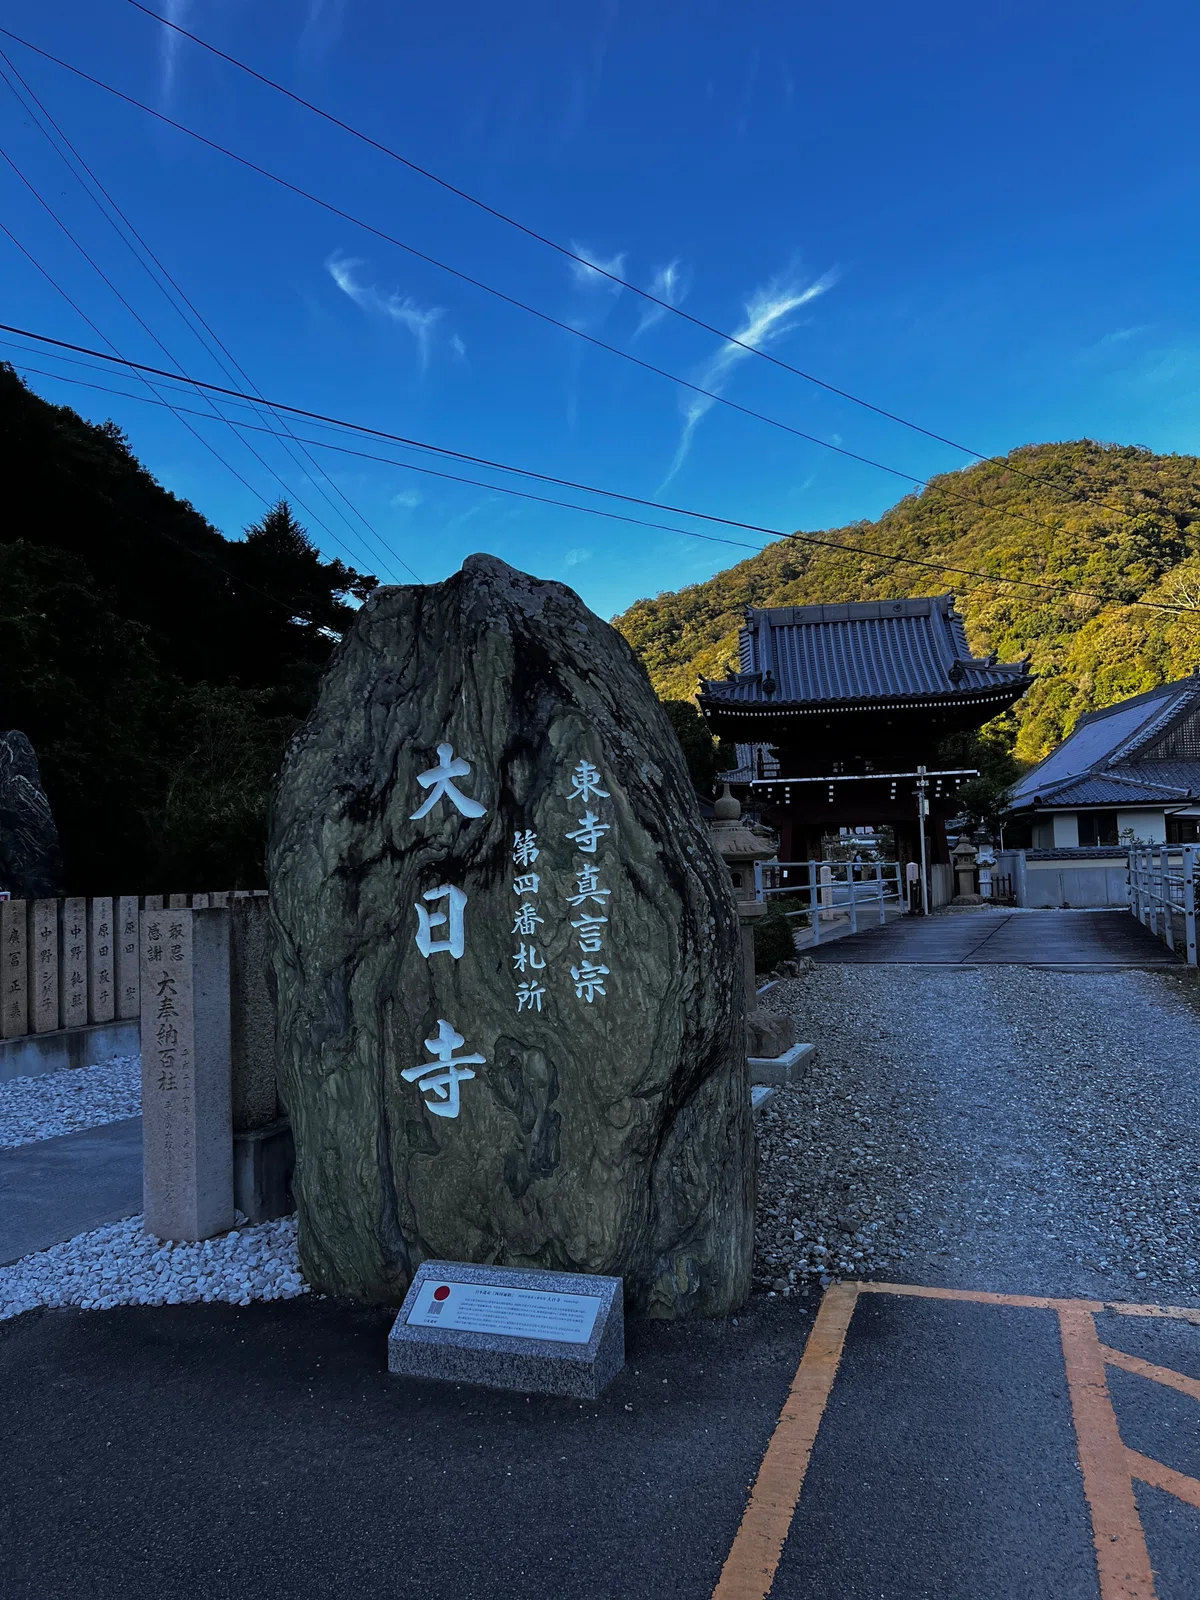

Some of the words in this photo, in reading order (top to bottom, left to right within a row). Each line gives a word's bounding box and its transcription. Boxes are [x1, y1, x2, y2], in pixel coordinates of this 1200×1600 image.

[147, 922, 163, 962] 感謝
[400, 742, 488, 1119] 大日寺
[511, 829, 547, 1013] 第四番札所
[565, 760, 612, 1003] 東寺真言宗
[156, 970, 179, 1091] 大奉納百柱
